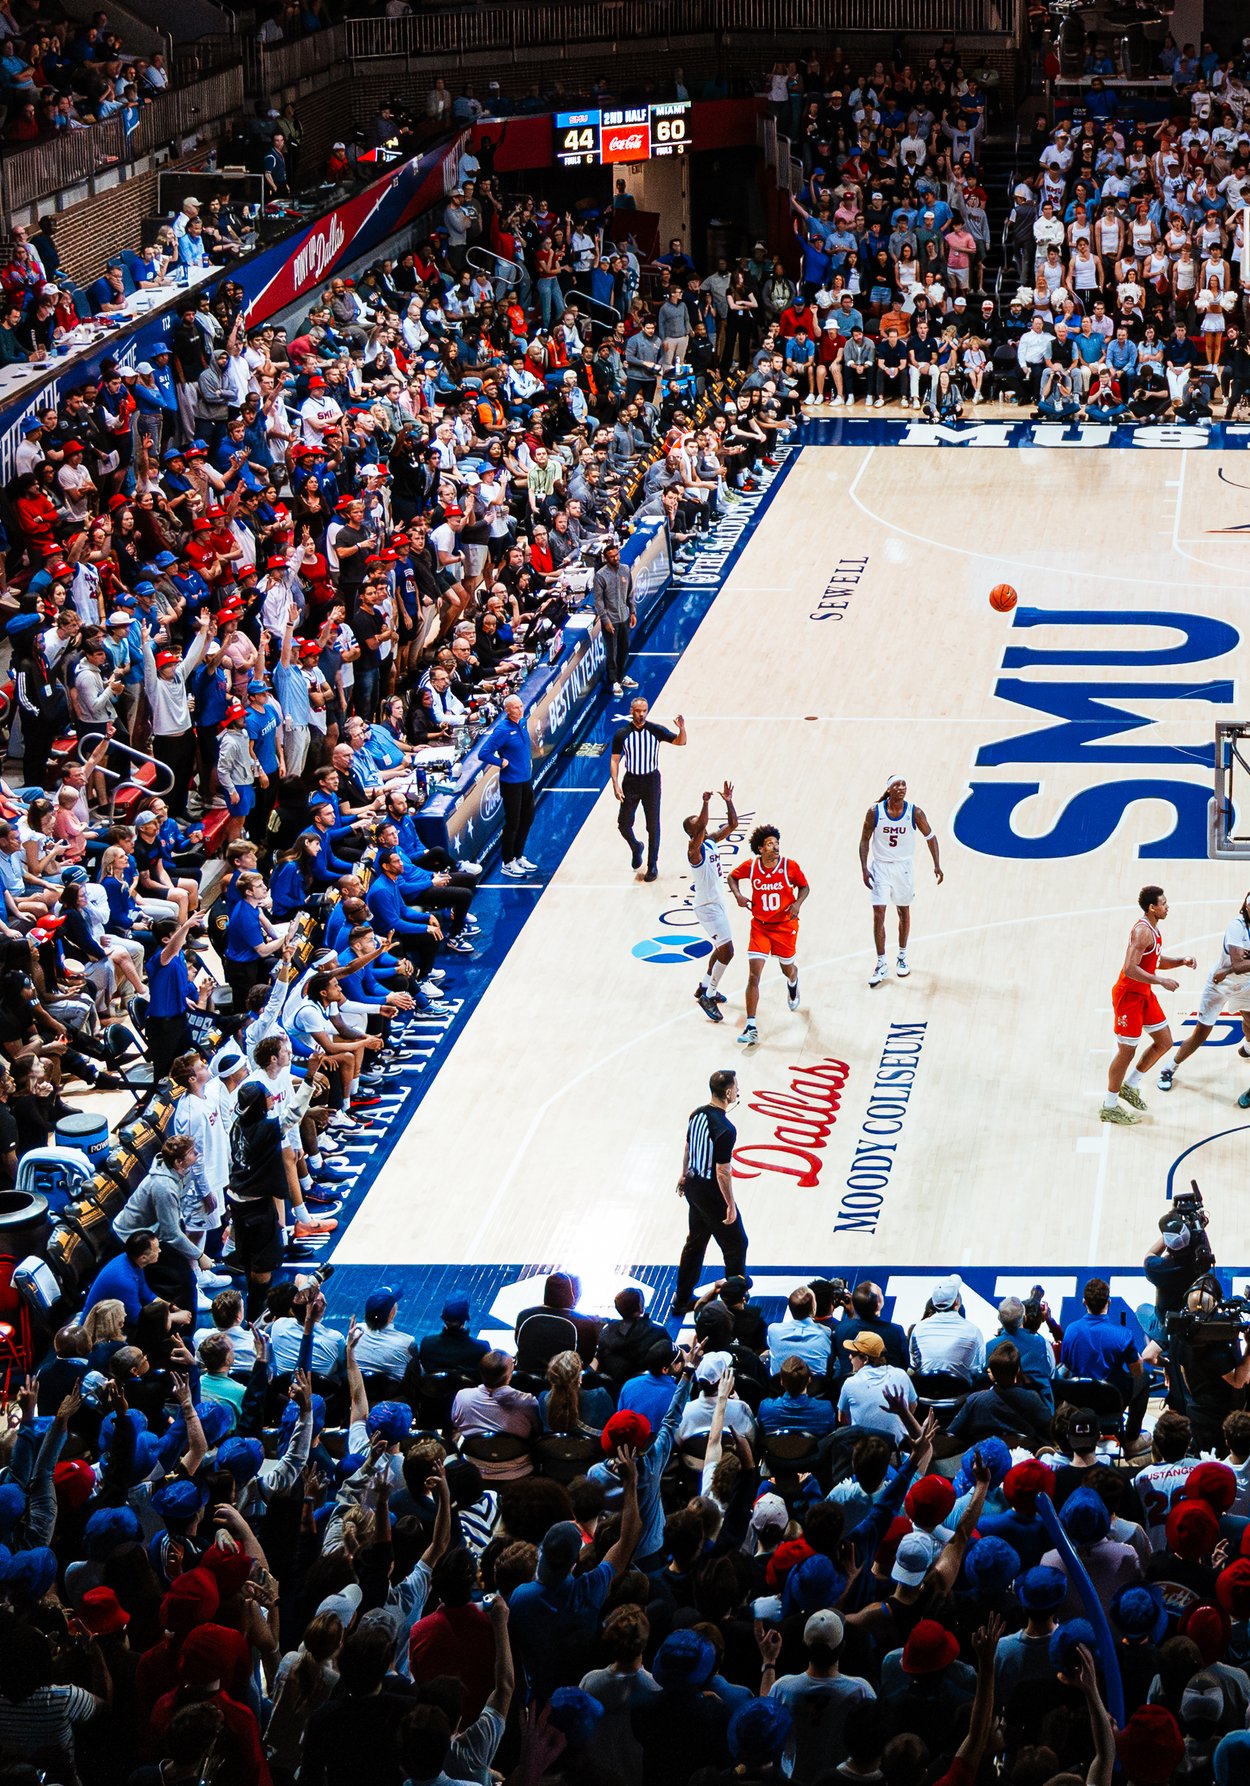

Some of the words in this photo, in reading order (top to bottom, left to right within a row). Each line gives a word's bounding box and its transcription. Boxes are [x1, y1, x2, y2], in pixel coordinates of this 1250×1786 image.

[603, 111, 623, 124] 2ND
[625, 109, 647, 123] HALF
[656, 105, 686, 116] MIAMI
[564, 128, 594, 151] 44
[657, 119, 686, 141] 60
[586, 154, 594, 164] 6
[677, 145, 685, 154] 3
[315, 212, 345, 279] Dallas
[687, 551, 731, 576] THE
[809, 556, 869, 621] SEWELL
[548, 683, 571, 735] BEST
[570, 665, 581, 703] IN
[580, 631, 606, 688] TEXAS
[953, 606, 1241, 859] SMU
[882, 826, 907, 835] SMU
[889, 835, 898, 847] 5
[753, 878, 784, 890] Canes
[761, 893, 780, 911] 10
[862, 1021, 928, 1135] COLISEUM
[731, 1058, 850, 1187] Dallas
[833, 1139, 898, 1235] MOODY
